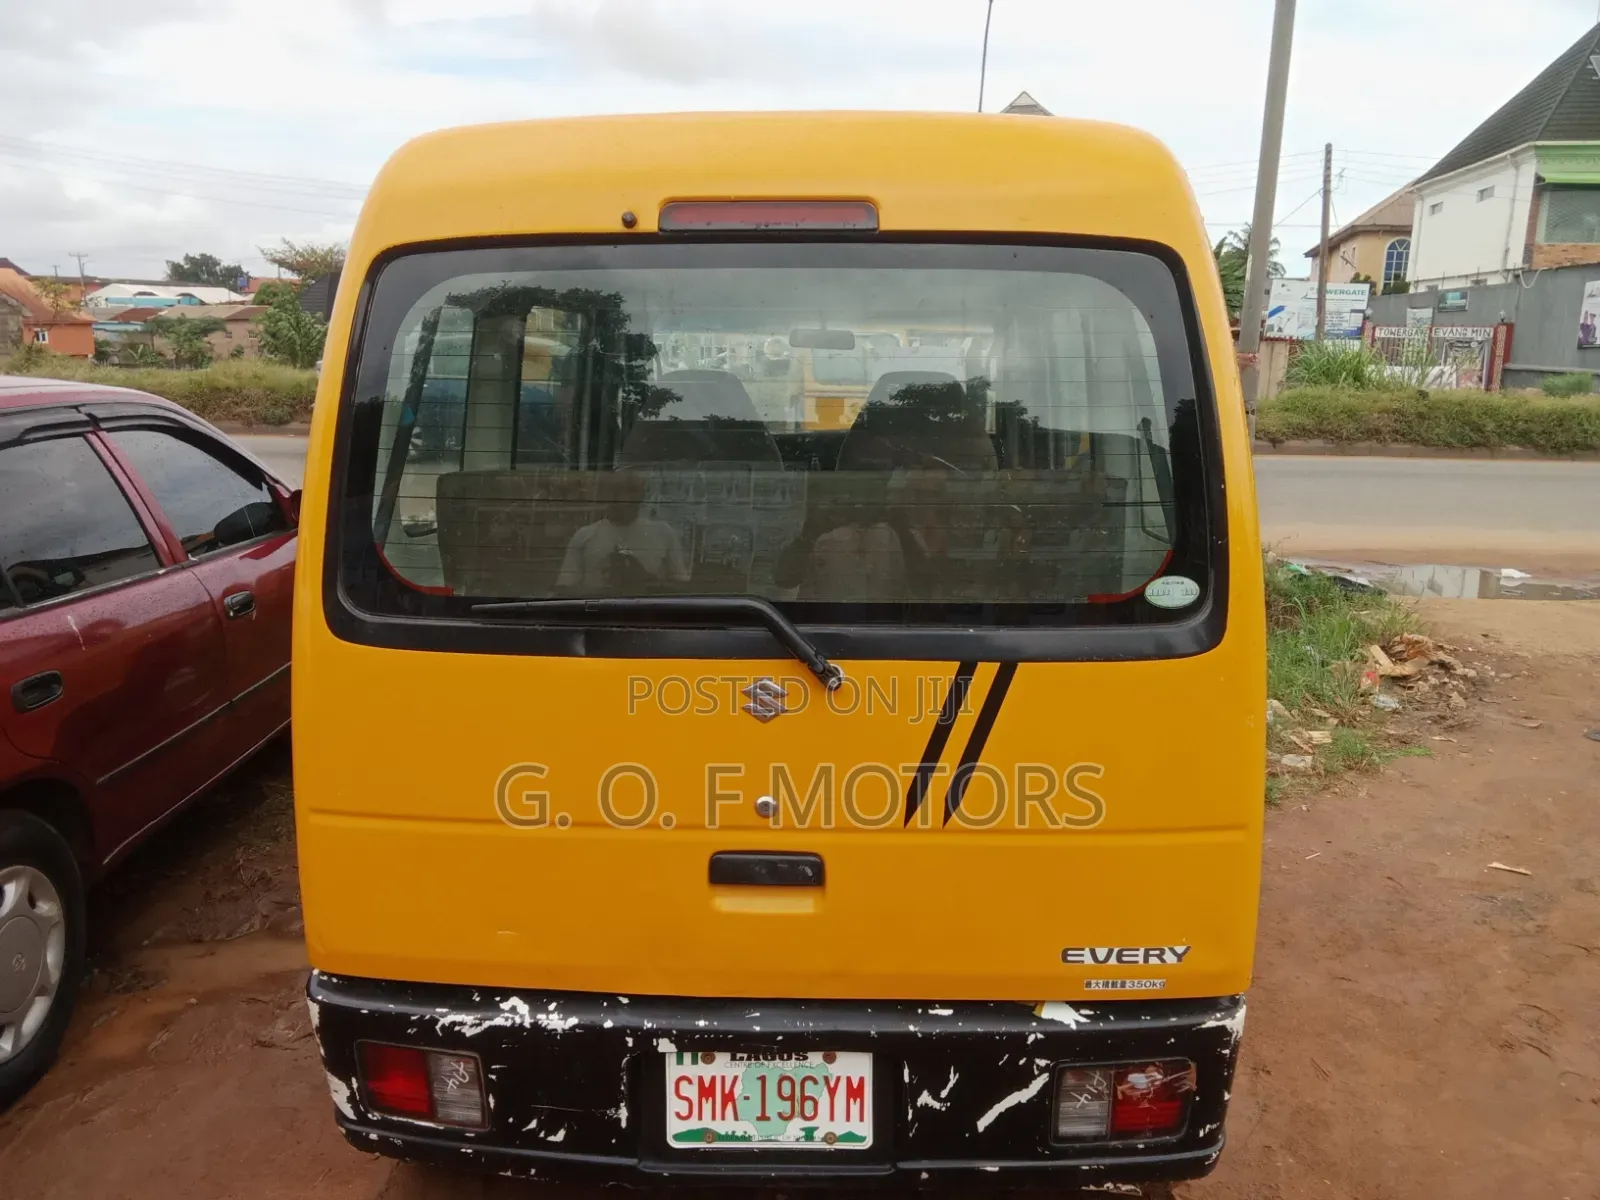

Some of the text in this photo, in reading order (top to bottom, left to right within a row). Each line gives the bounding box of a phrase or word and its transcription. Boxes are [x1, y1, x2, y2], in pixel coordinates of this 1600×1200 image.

[1471, 327, 1491, 337] MIN
[1061, 945, 1192, 965] EVERY
[729, 1052, 809, 1061] LAGOS
[724, 1061, 814, 1069] CENTRE OF EXCELLENCE
[674, 1075, 865, 1122] SMK-196YM
